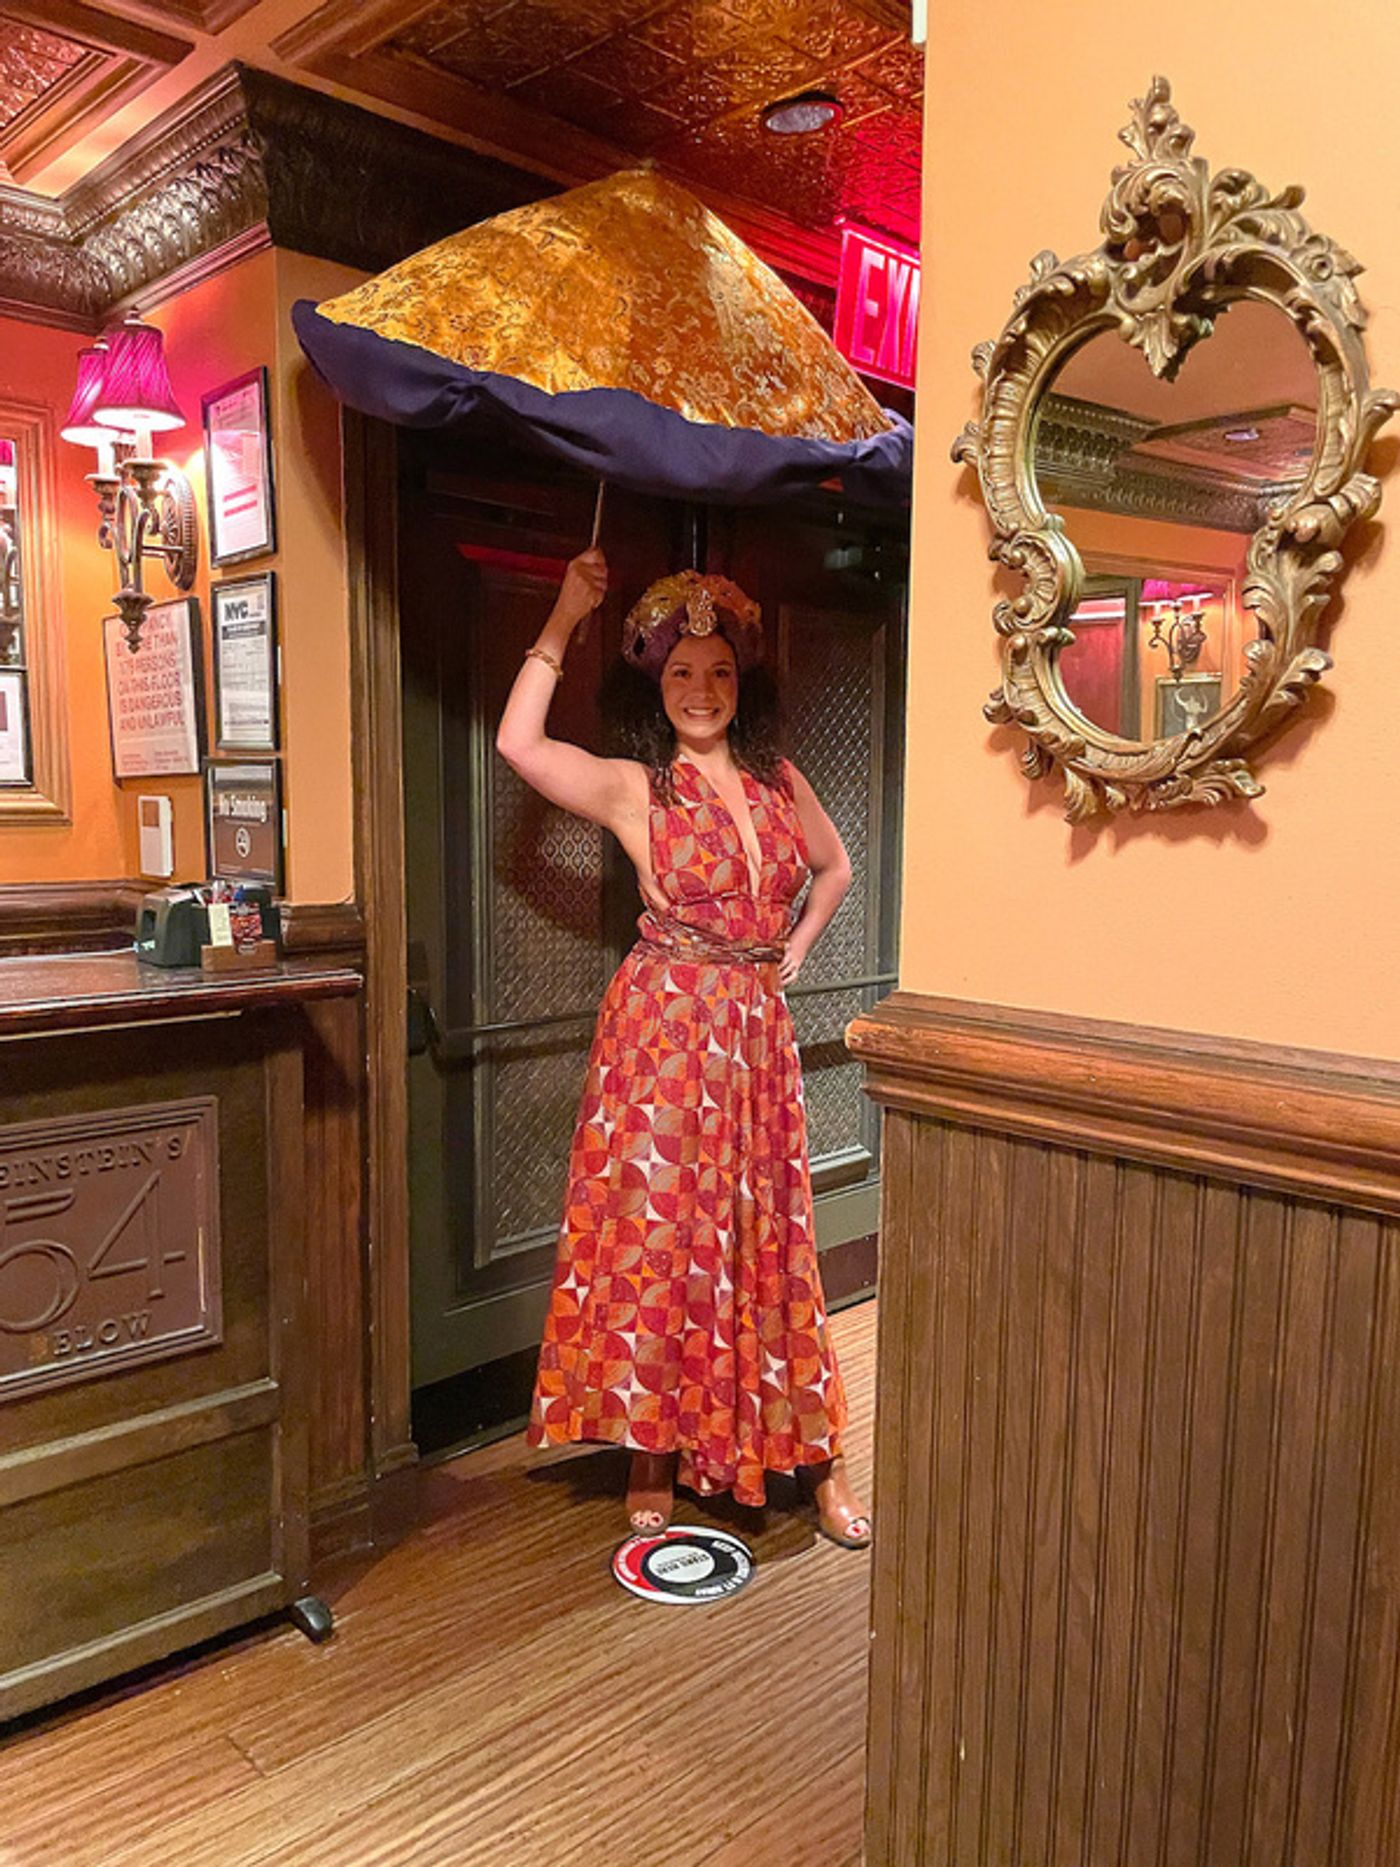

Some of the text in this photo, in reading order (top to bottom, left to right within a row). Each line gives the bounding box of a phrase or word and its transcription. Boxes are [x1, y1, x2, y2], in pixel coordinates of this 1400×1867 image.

[224, 601, 248, 621] NYC
[136, 653, 177, 673] PERSONS
[151, 671, 181, 690] FLOOR
[129, 690, 183, 712] DANGEROUS
[120, 710, 186, 731] AND UNLAWFUL
[231, 794, 267, 823] Smoking
[53, 1308, 152, 1356] ELOW
